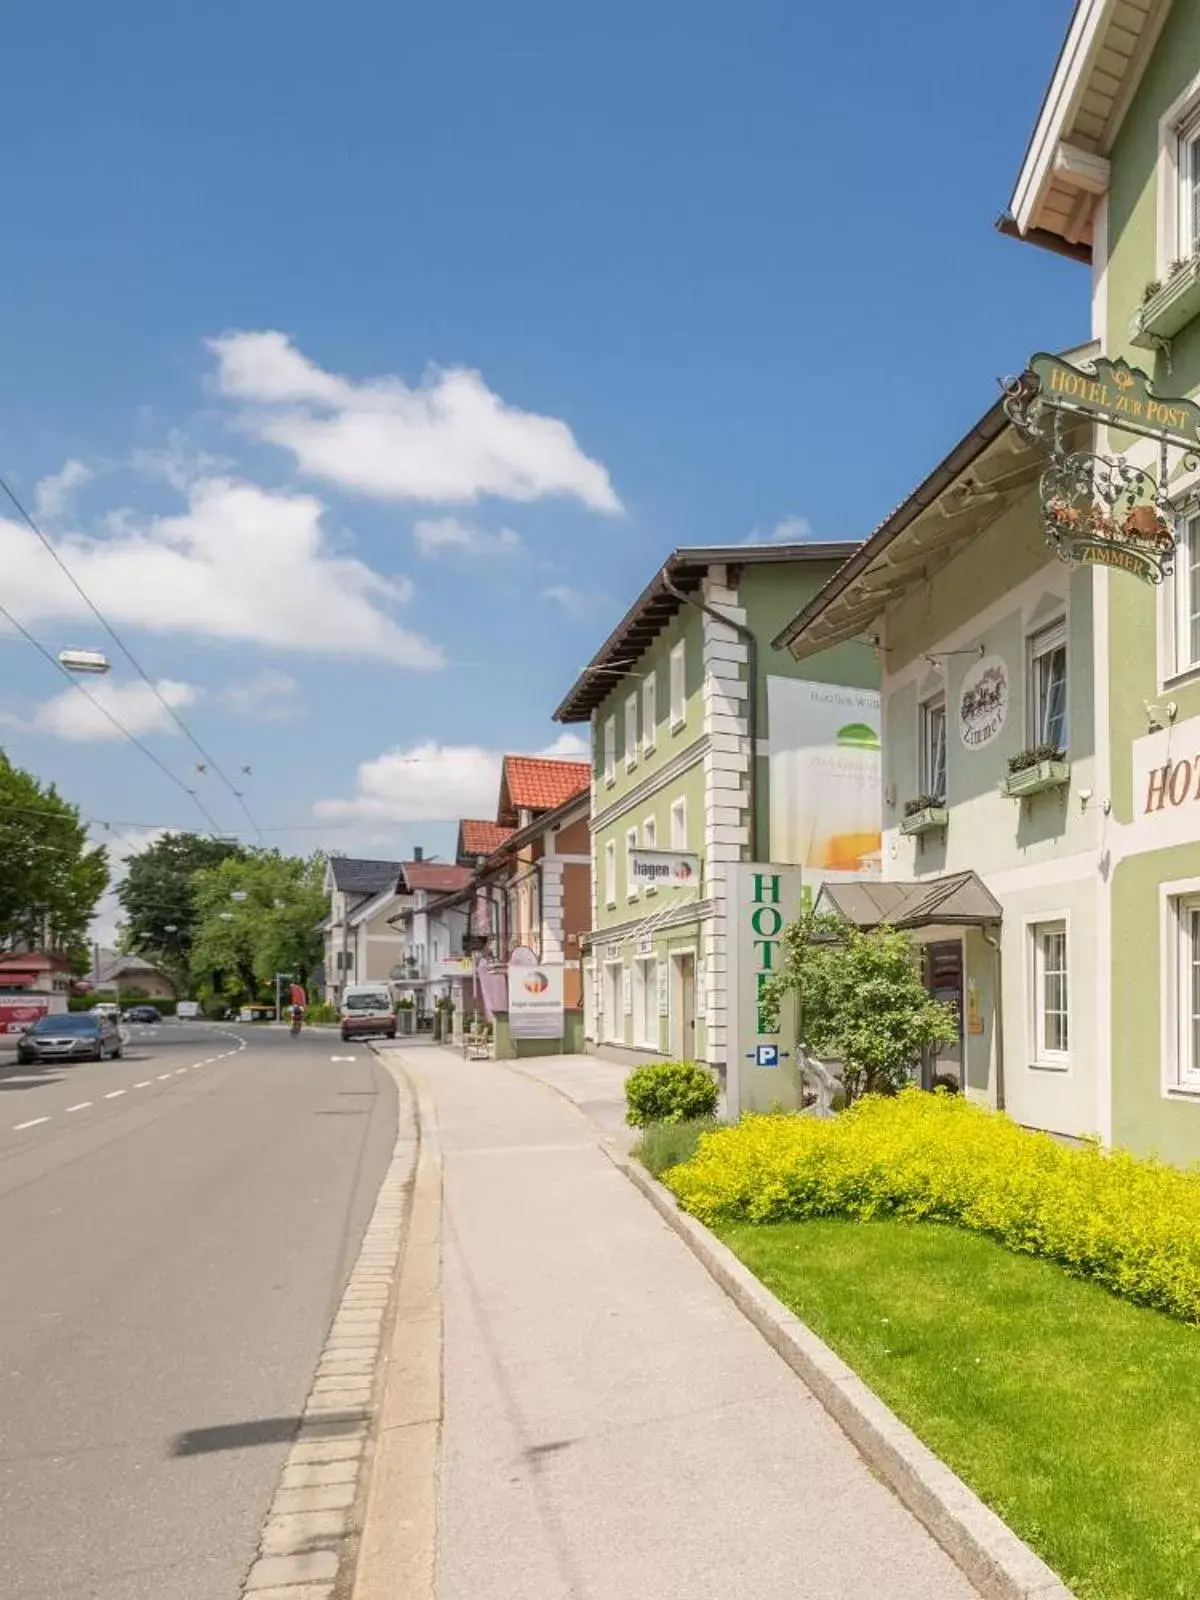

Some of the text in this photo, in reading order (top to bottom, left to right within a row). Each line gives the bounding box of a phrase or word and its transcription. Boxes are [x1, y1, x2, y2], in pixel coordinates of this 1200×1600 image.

[1050, 368, 1190, 430] HOTEL ZUR POST
[1081, 546, 1145, 573] ZIMMER
[632, 860, 670, 880] hagen
[759, 1047, 775, 1066] P
